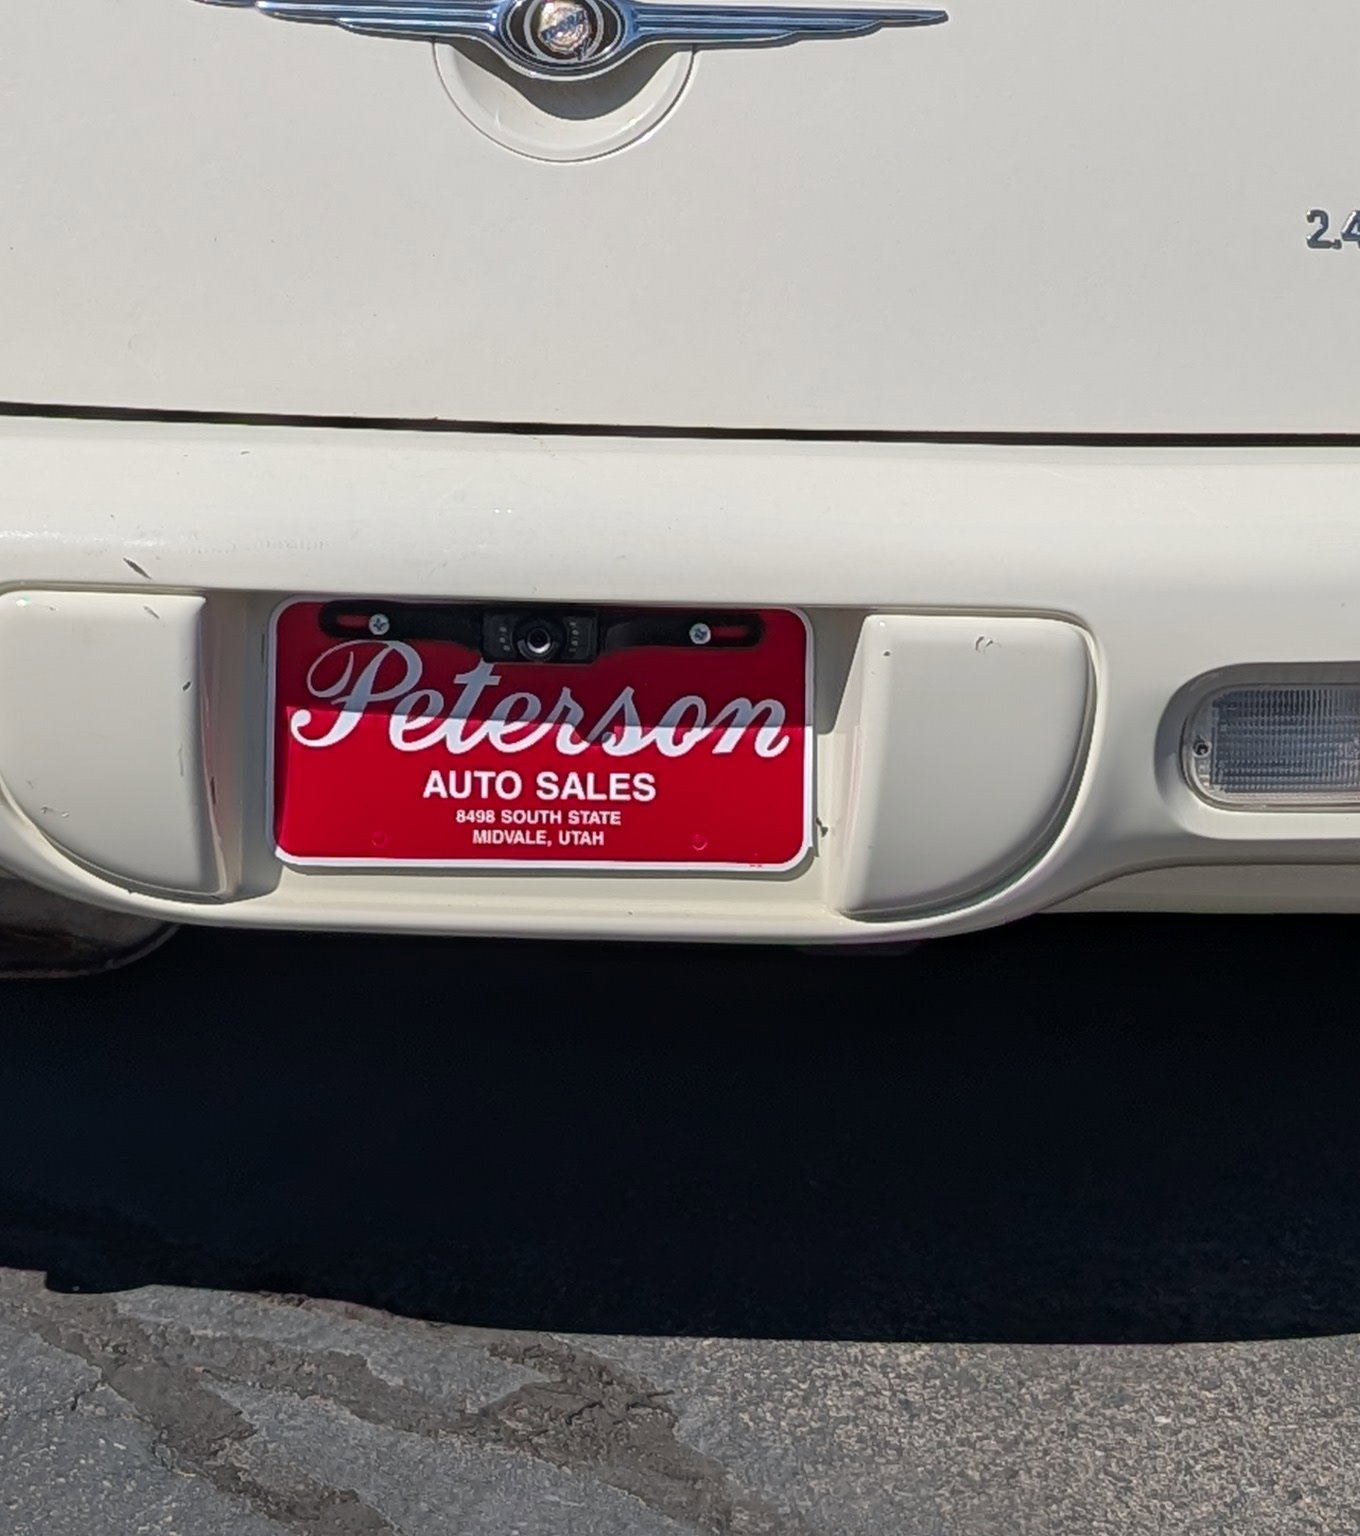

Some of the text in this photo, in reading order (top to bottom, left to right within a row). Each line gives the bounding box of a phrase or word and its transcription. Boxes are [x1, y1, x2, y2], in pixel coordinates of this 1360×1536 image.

[290, 638, 791, 758] Peterson
[422, 769, 657, 802] AUTO SALES
[455, 809, 622, 826] 8498 SOUTH STATE
[472, 829, 605, 848] MIDVALE, UTAH
